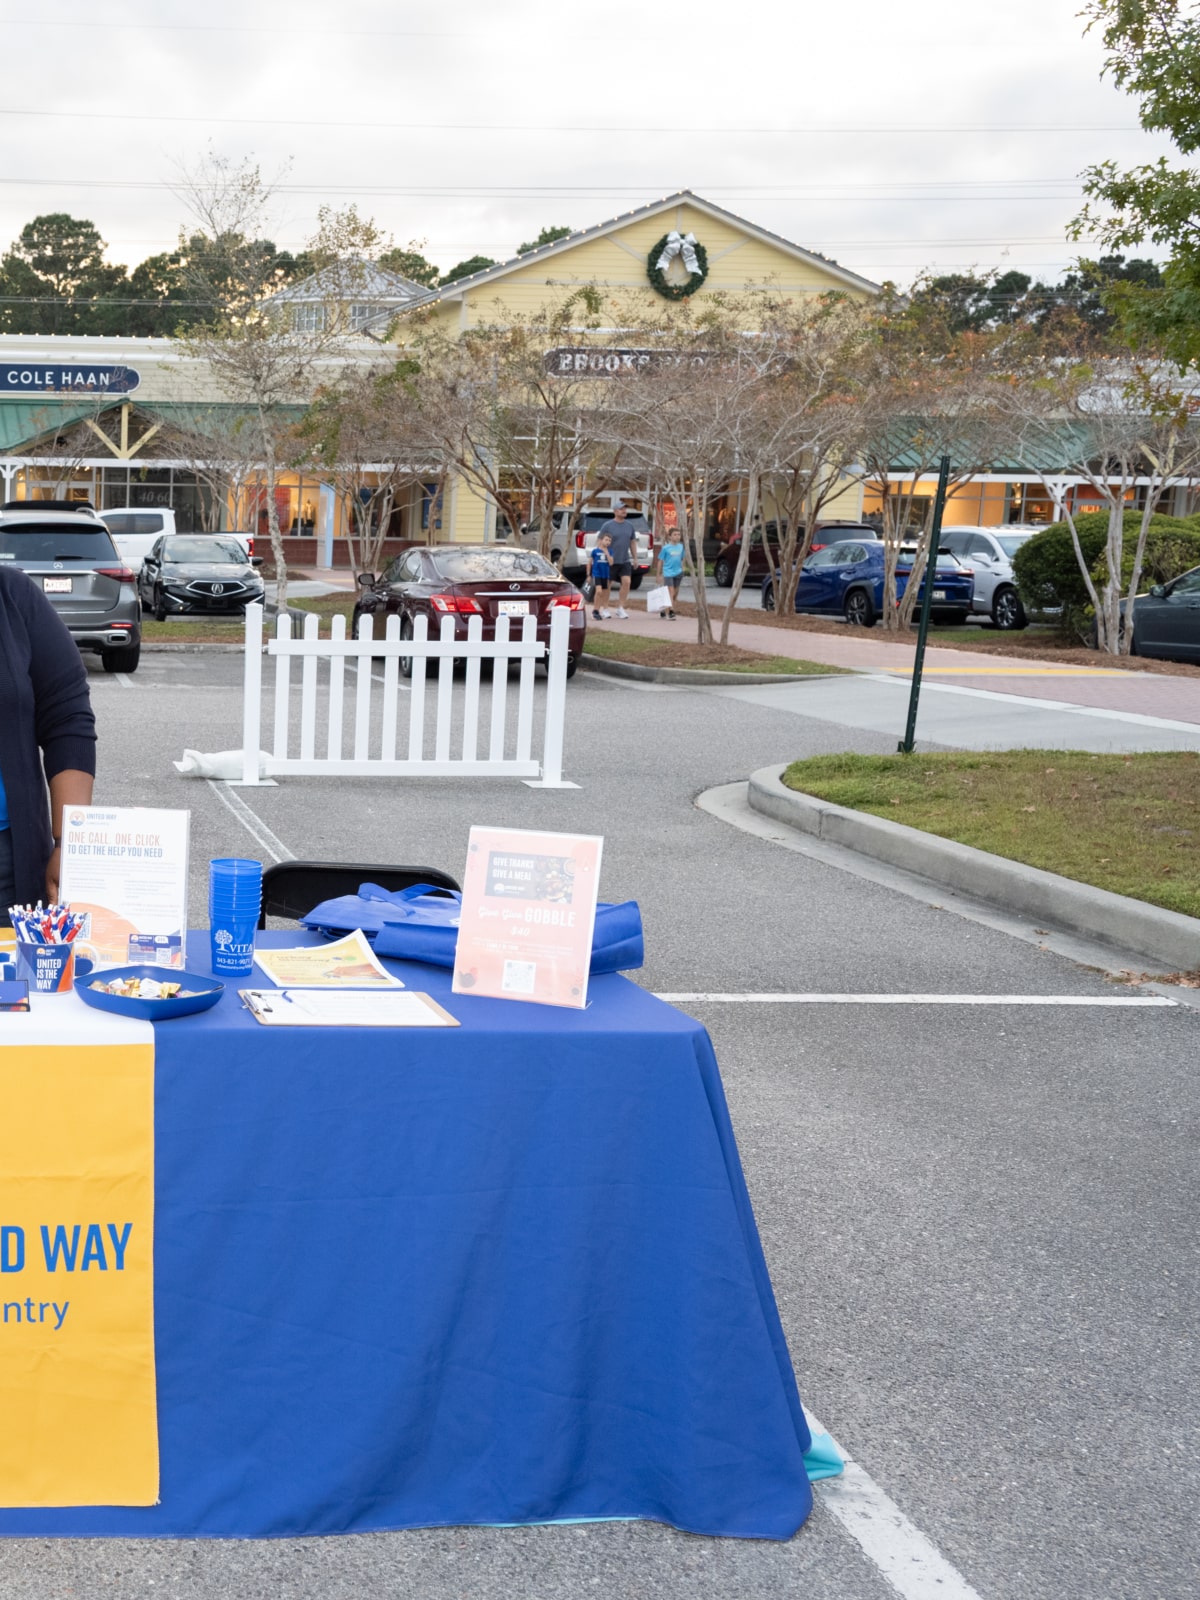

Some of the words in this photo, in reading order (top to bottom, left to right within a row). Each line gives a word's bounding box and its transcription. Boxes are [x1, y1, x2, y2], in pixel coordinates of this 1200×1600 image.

[7, 371, 54, 384] COLE
[62, 372, 110, 386] HAAN
[68, 831, 86, 844] ONE
[115, 833, 132, 845] ONE
[68, 844, 76, 854] TO
[78, 845, 91, 855] GET
[93, 845, 106, 855] THE
[108, 845, 126, 857] HELP
[127, 846, 142, 857] YOU
[144, 847, 163, 858] NEED
[493, 857, 509, 867] GIVE
[492, 869, 507, 879] GIVE
[525, 907, 577, 928] GOBBLE
[230, 944, 253, 953] VITA
[36, 959, 62, 970] UNITED
[36, 970, 44, 979] IS
[45, 970, 58, 980] THE
[36, 980, 52, 990] WAY
[40, 1222, 134, 1273] WAY
